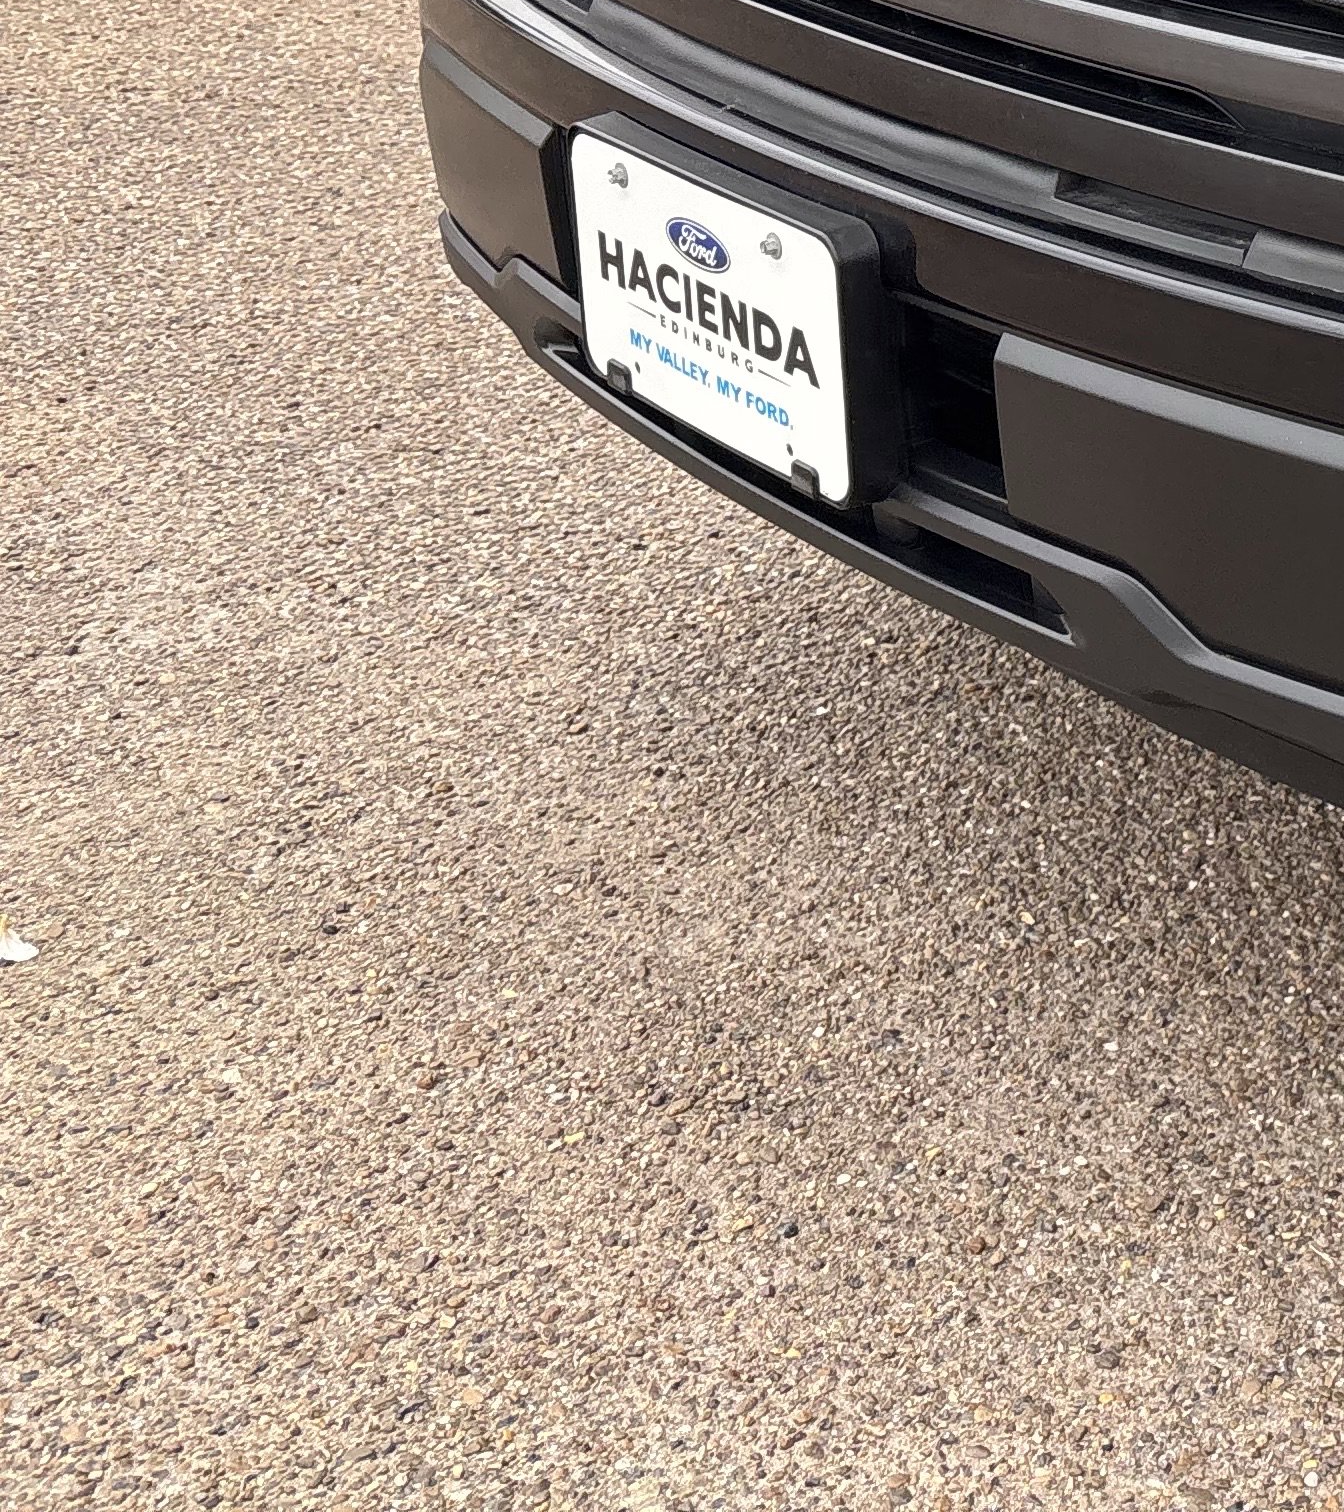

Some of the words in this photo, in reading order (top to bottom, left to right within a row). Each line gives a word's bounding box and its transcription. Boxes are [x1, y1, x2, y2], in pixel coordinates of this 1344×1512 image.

[678, 223, 718, 268] Ford
[597, 229, 821, 390] HACIENDA
[659, 313, 754, 373] EDINBURG
[629, 327, 652, 355] MY
[655, 342, 711, 388] VALLEY.
[716, 375, 742, 403] MY
[745, 391, 794, 430] FORD.
